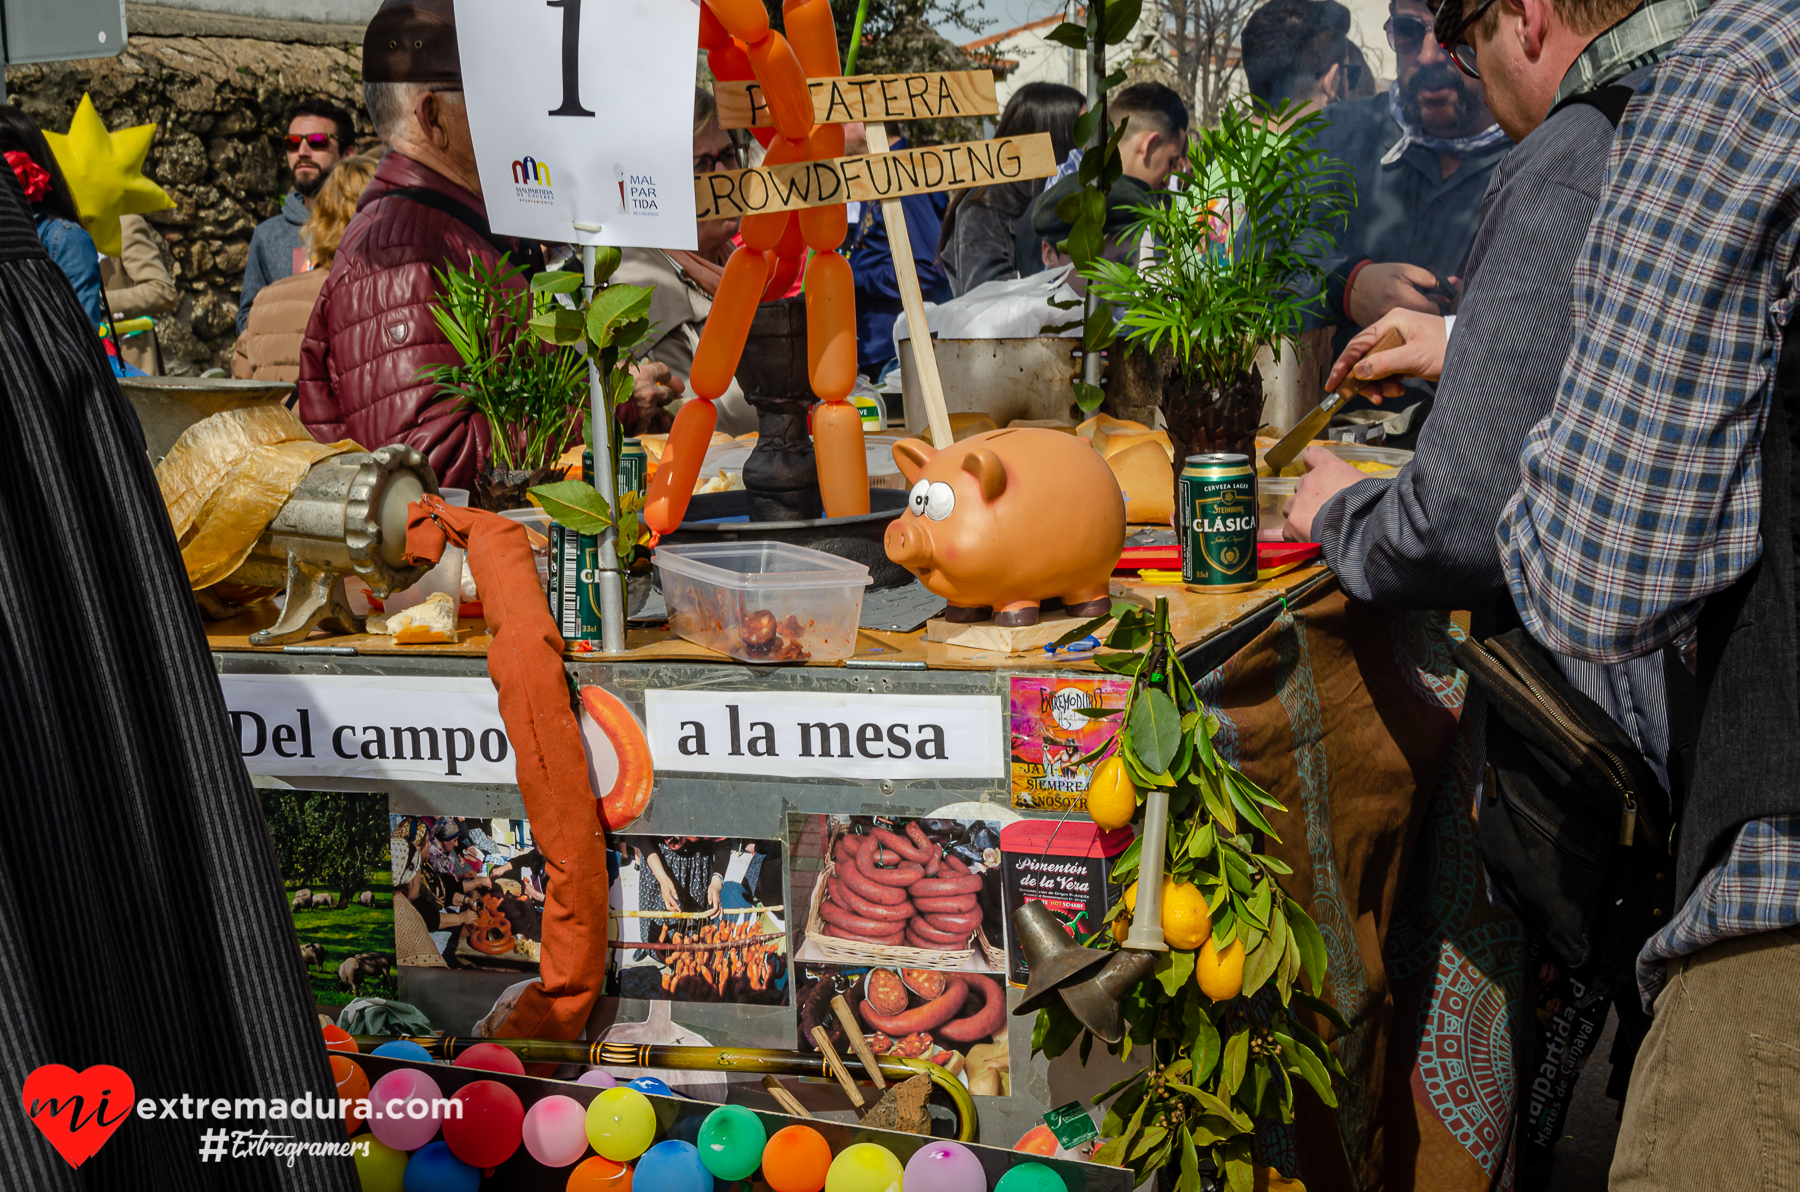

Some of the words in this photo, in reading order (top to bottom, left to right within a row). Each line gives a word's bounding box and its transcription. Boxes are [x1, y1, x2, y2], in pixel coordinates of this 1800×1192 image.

[546, 0, 596, 118] 1
[746, 75, 960, 126] PATERA
[630, 175, 656, 186] MAL
[630, 187, 657, 198] PAR
[632, 198, 658, 210] TIDA
[1203, 483, 1232, 492] CERVEZA
[1192, 515, 1256, 533] CLÁSICA
[582, 625, 597, 633] 33cl
[678, 720, 710, 756] a
[725, 704, 780, 757] la
[797, 722, 949, 760] mesa
[229, 708, 316, 758] Del
[331, 724, 508, 776] campo
[1026, 778, 1083, 792] SIEMPRE
[1015, 856, 1088, 876] Pimentón
[1020, 874, 1037, 888] de
[1039, 875, 1055, 890] la
[1056, 876, 1090, 892] Vera
[1560, 1016, 1595, 1076] Carnaval
[1554, 1081, 1569, 1098] de
[1533, 1101, 1561, 1148] Martes
